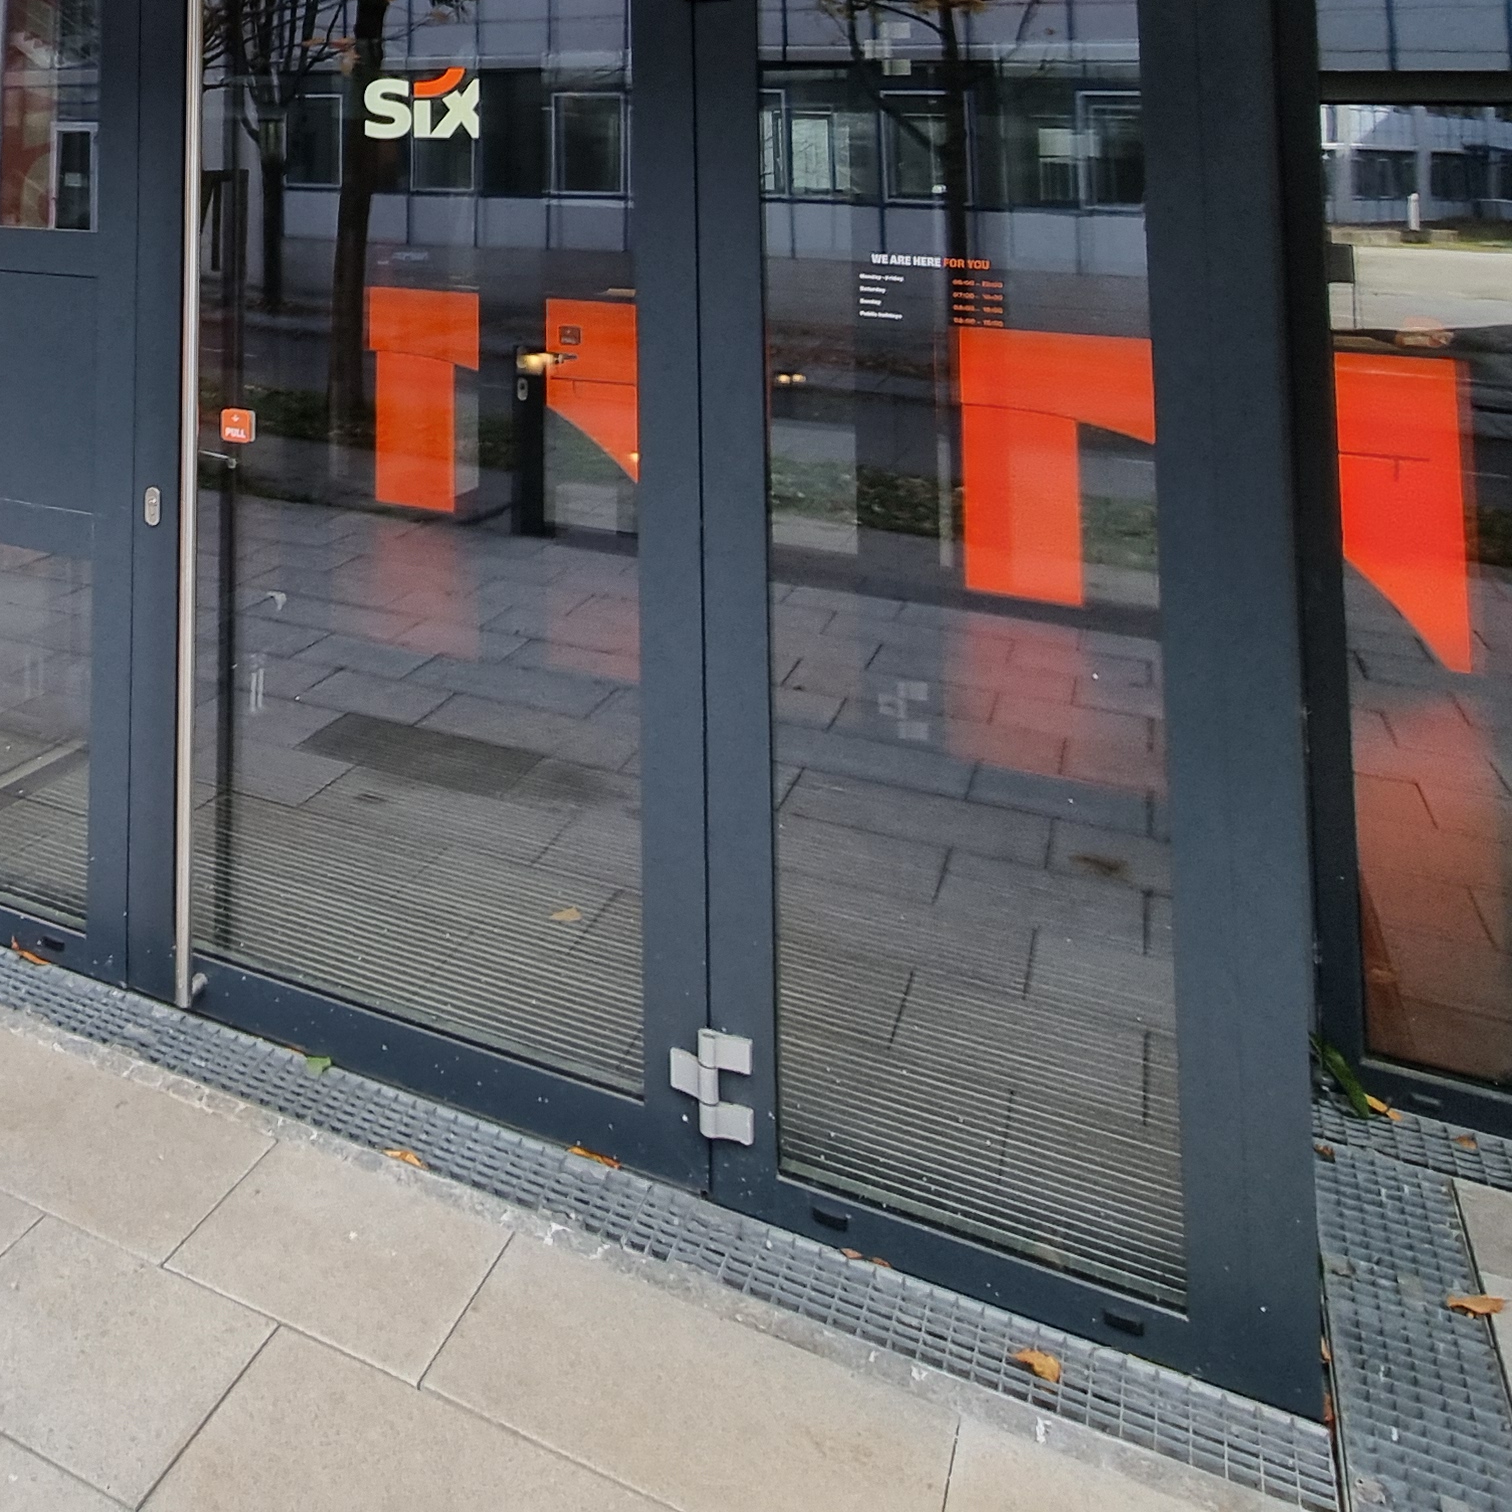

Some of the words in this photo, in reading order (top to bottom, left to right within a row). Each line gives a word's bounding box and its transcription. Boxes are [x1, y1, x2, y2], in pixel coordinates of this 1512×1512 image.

[871, 253, 888, 264] WE
[889, 255, 911, 266] ARE
[913, 256, 941, 268] HERE
[943, 257, 965, 269] FOR
[967, 259, 990, 270] YOU
[225, 427, 246, 439] PULL
